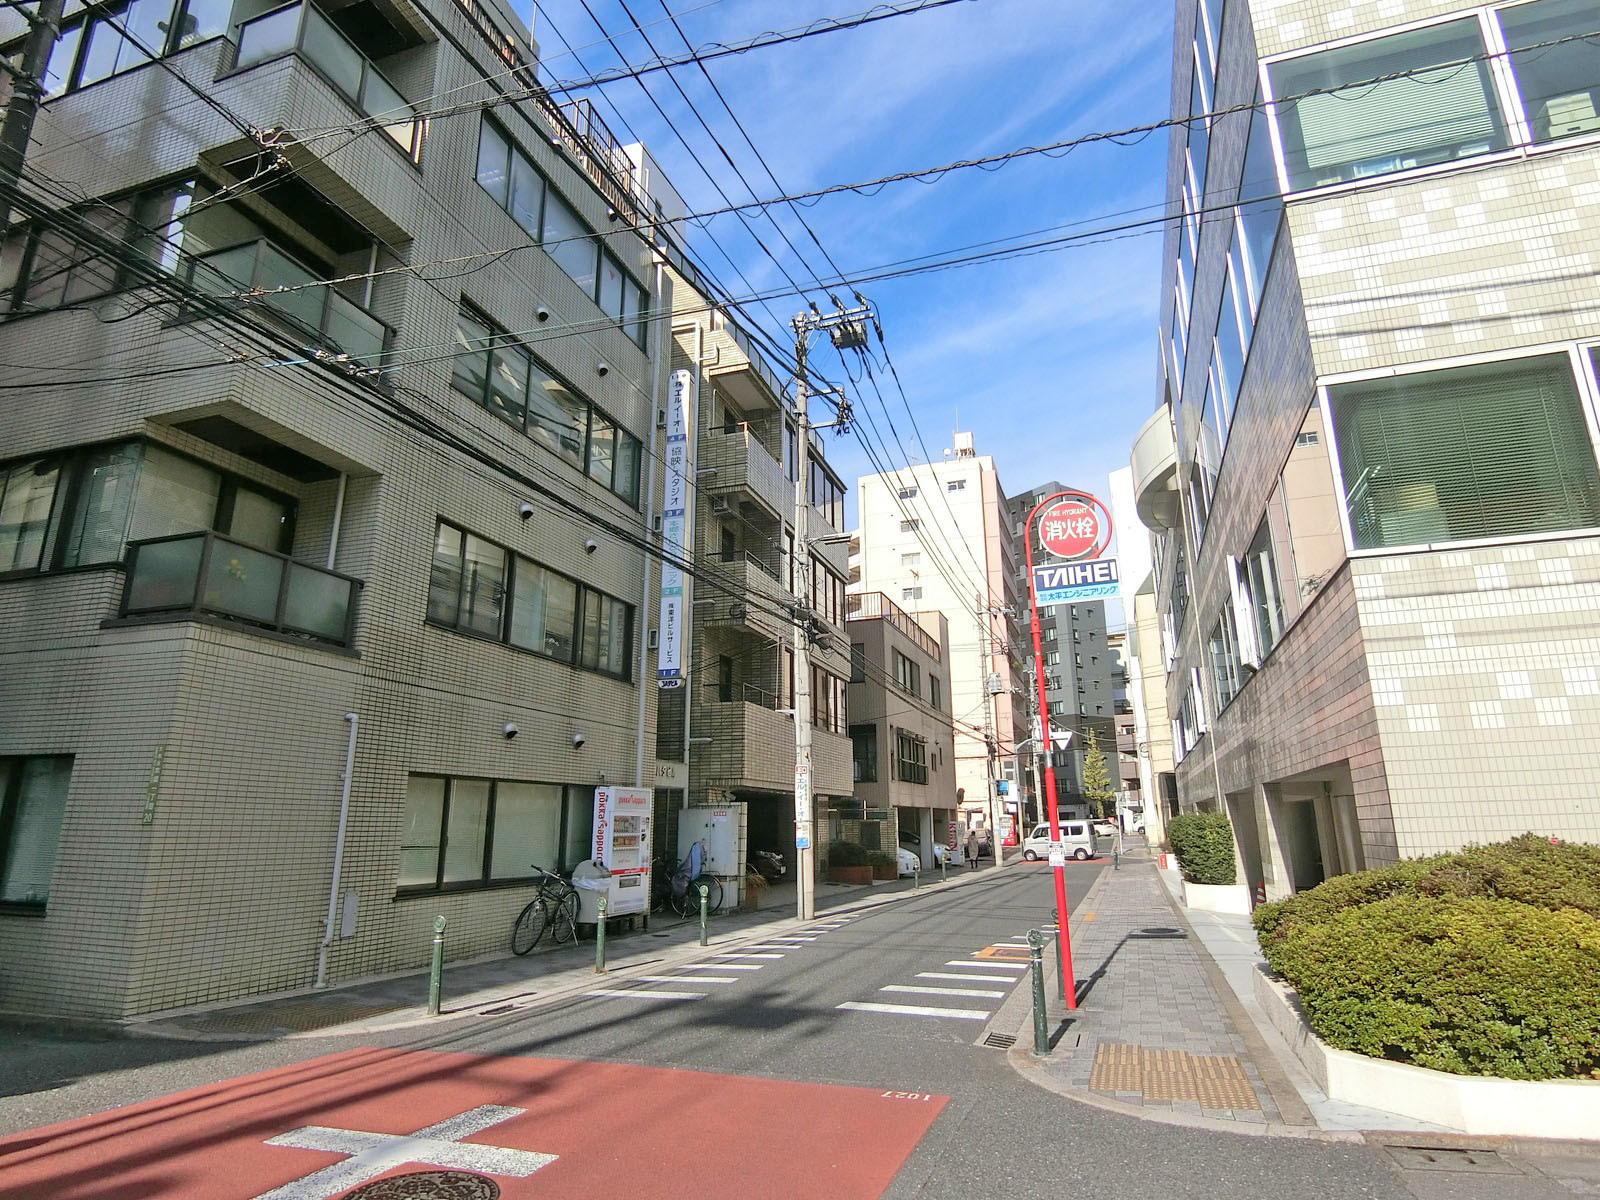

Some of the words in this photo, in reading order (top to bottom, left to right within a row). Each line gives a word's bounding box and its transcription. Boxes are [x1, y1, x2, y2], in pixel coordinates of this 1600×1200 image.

[667, 509, 682, 517] 3F
[1048, 509, 1061, 517] FIRE
[1062, 507, 1087, 516] HYDRANT
[1045, 516, 1094, 542] 消火栓
[1037, 561, 1117, 588] TAIHEI
[665, 587, 679, 595] 2F
[663, 669, 677, 677] 1F
[143, 813, 152, 823] 20
[881, 1091, 931, 1101] 1027
